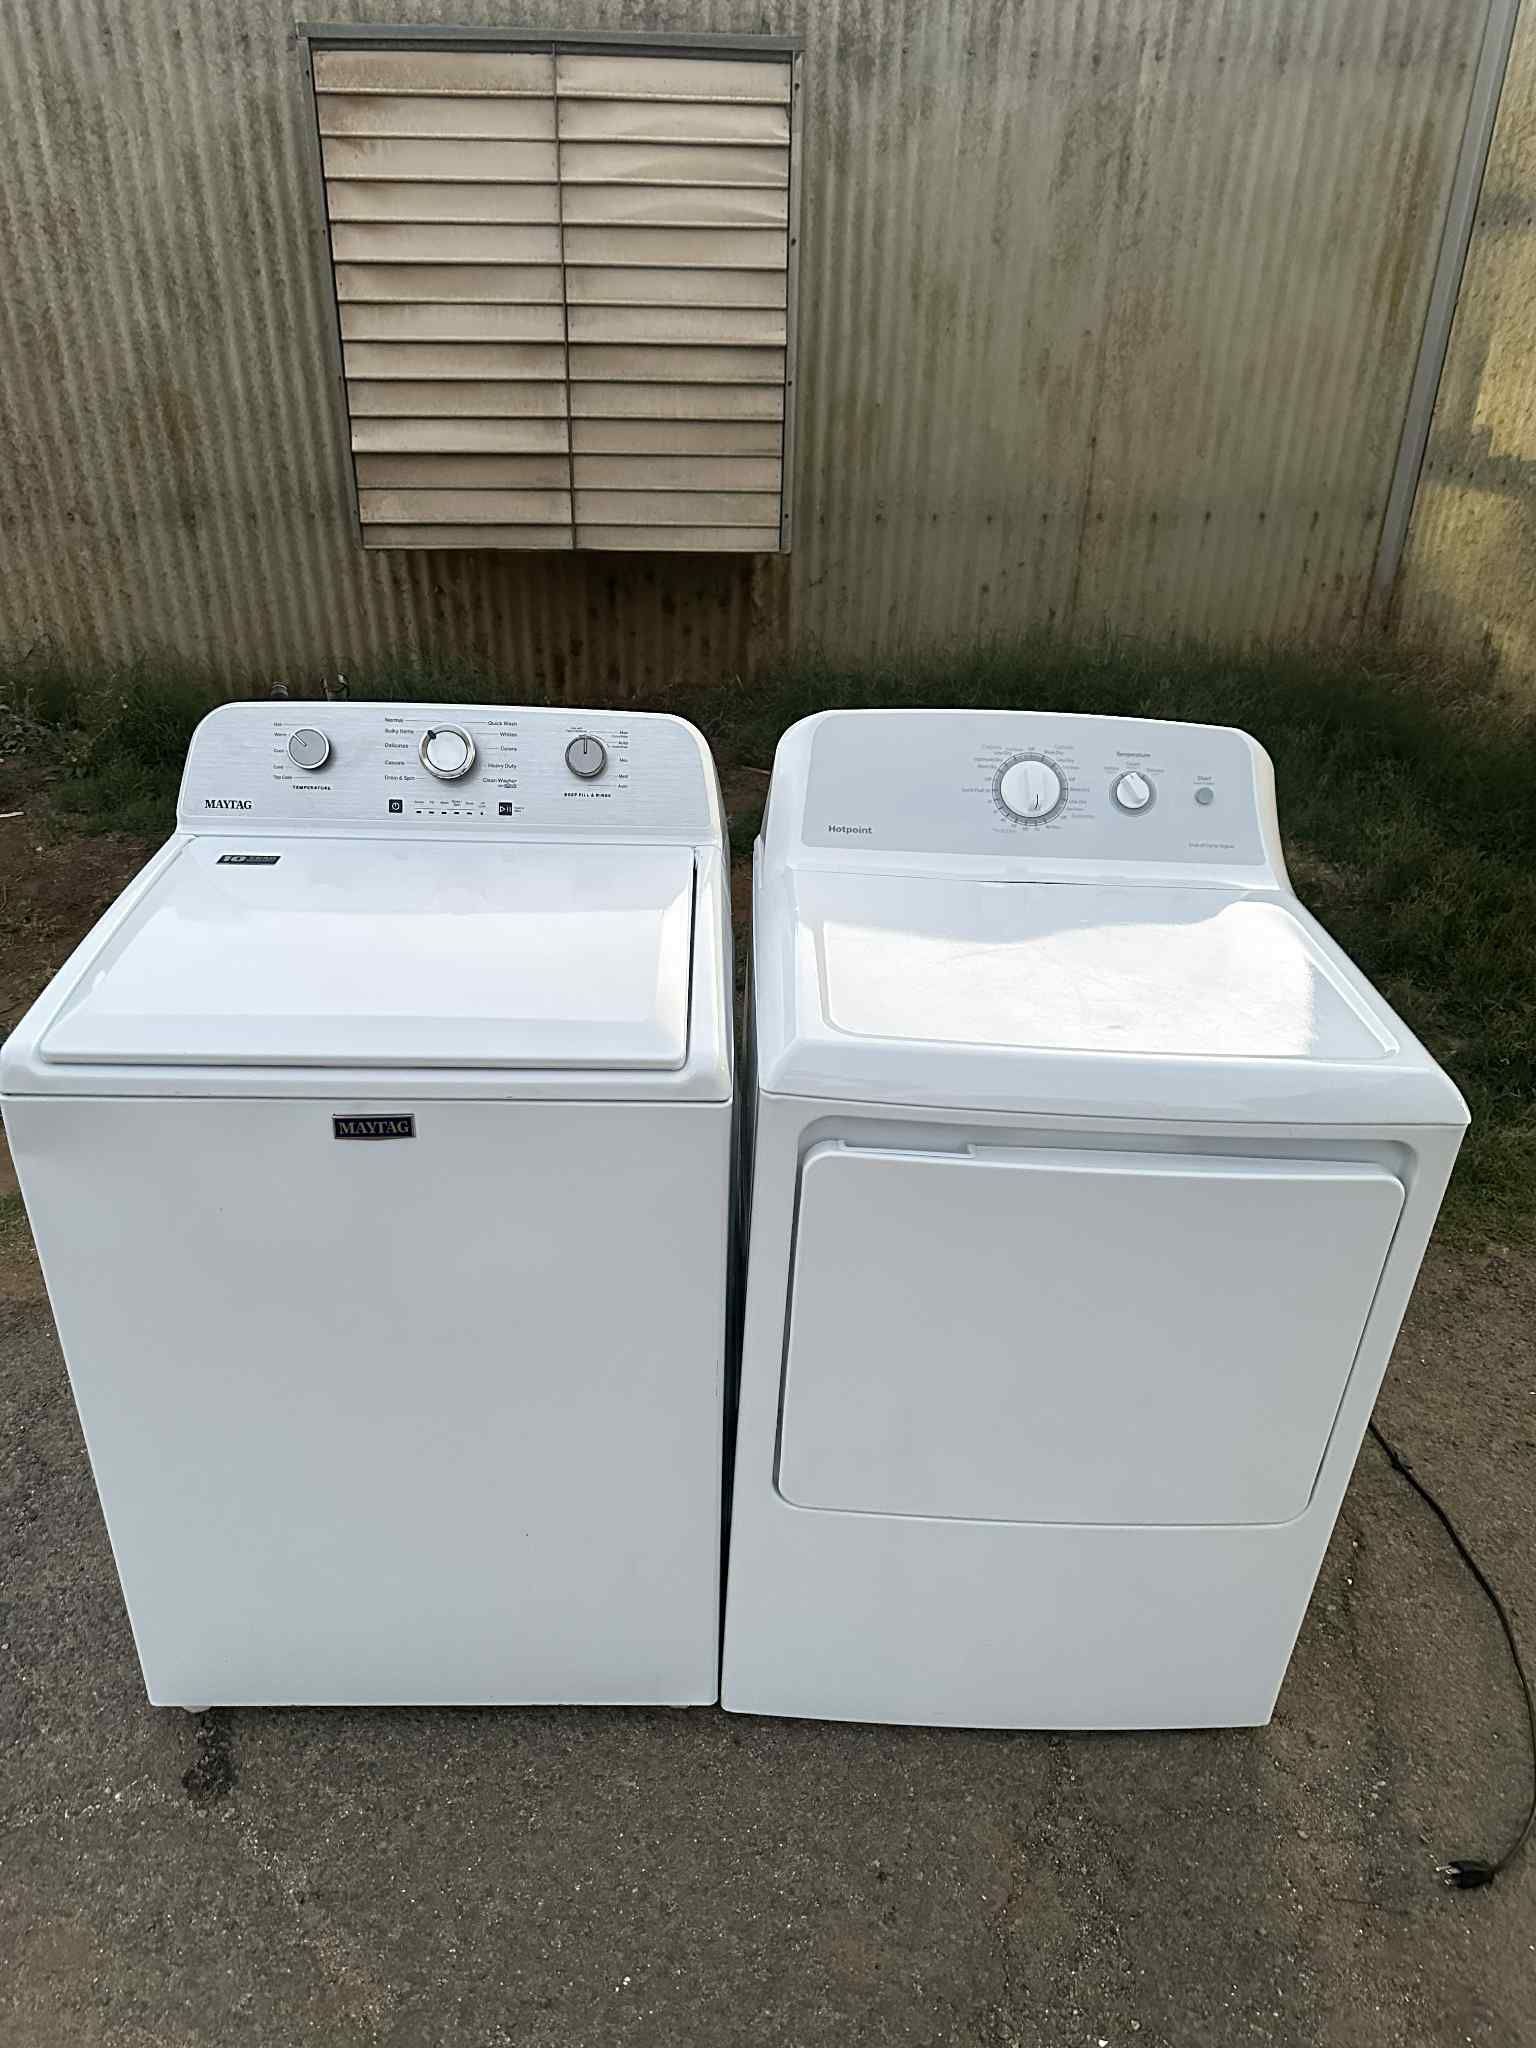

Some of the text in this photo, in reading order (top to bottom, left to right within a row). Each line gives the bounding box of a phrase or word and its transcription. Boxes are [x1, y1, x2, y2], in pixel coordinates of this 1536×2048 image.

[204, 799, 253, 811] MAYTAG
[827, 824, 873, 836] Hotpoint
[336, 1120, 410, 1135] MAYTAG
